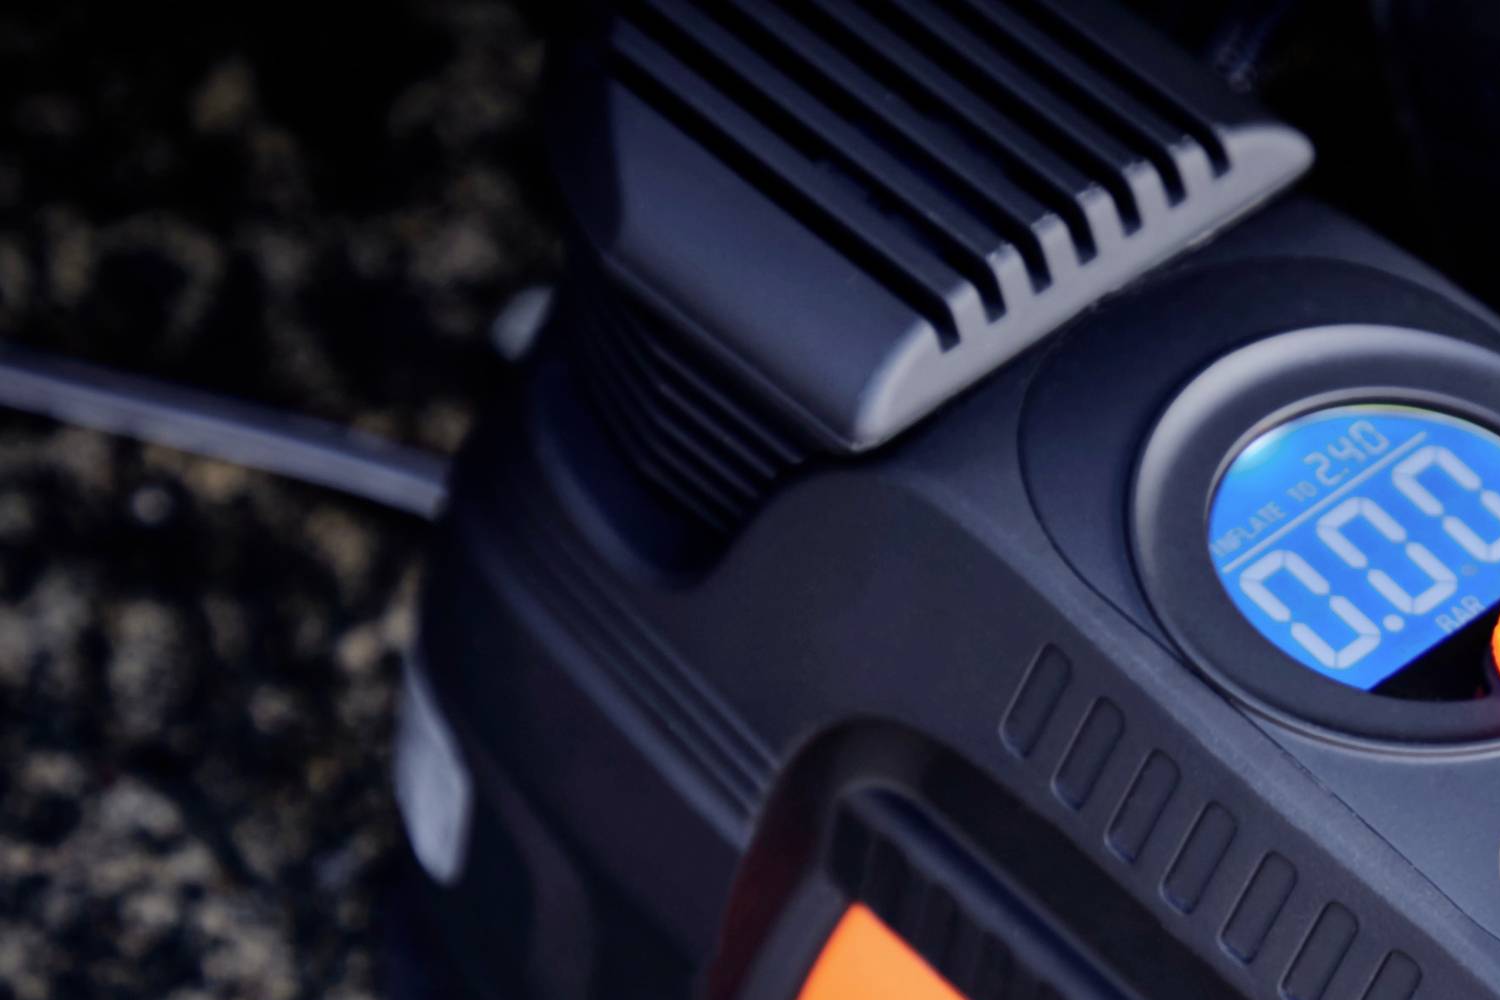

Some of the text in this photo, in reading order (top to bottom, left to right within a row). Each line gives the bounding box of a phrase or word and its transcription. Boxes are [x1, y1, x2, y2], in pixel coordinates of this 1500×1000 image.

[1286, 481, 1318, 503] TO
[1304, 419, 1390, 487] 2.40
[1435, 594, 1487, 634] BAR
